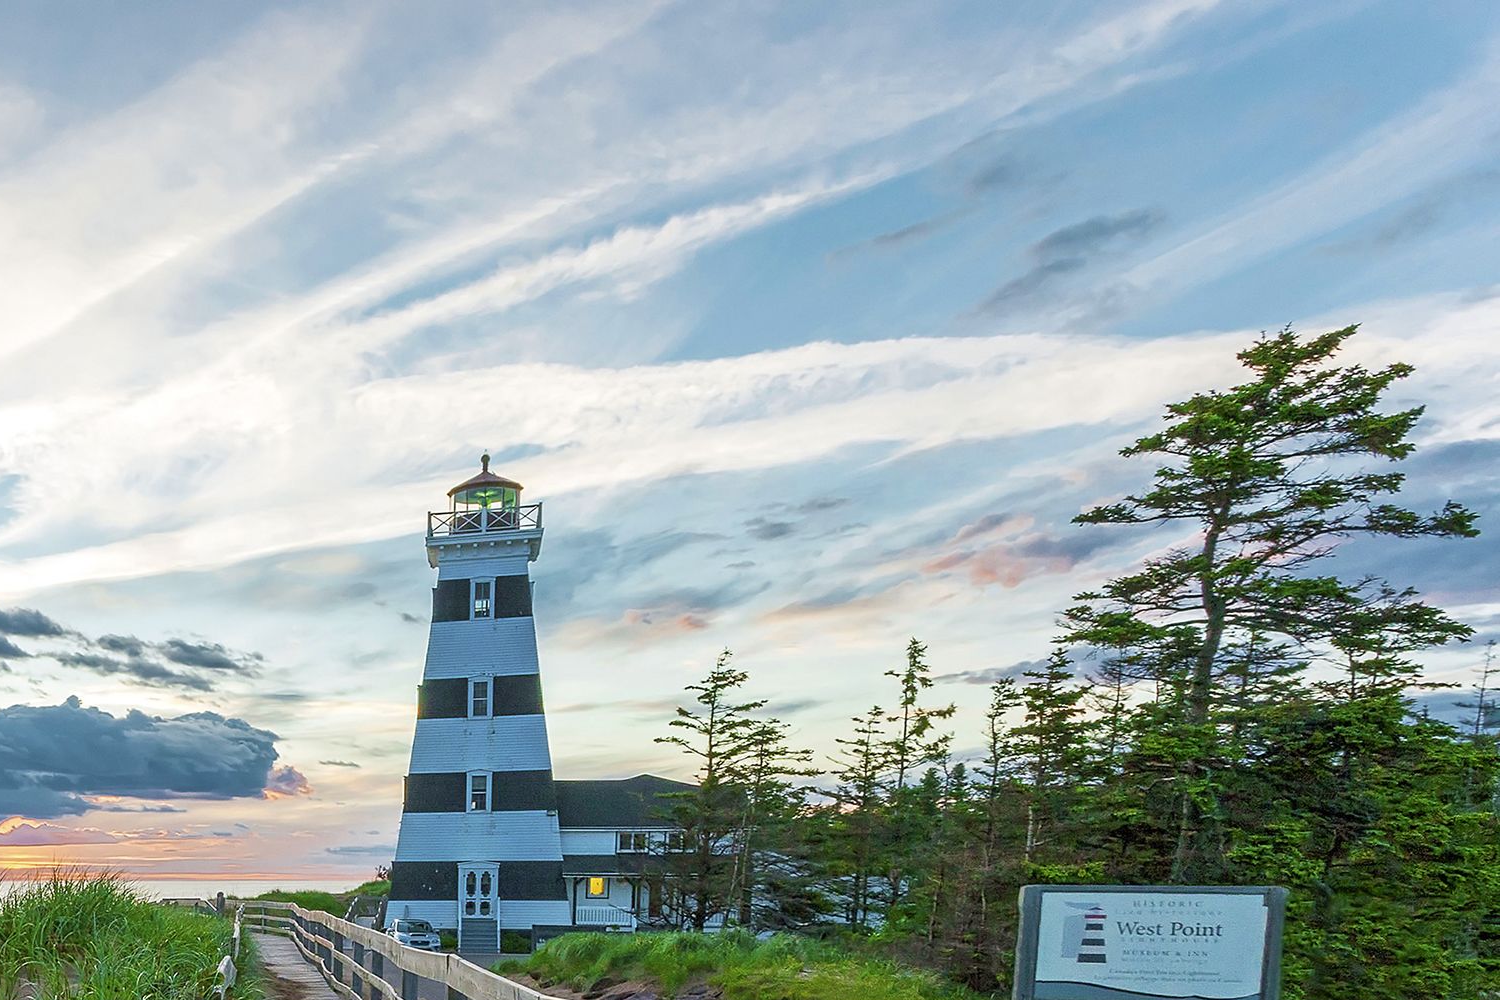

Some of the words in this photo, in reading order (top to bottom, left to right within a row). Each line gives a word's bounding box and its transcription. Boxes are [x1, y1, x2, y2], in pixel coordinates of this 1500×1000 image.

[1133, 900, 1205, 908] HISTORIC
[1116, 921, 1163, 936] West
[1170, 921, 1223, 937] Point
